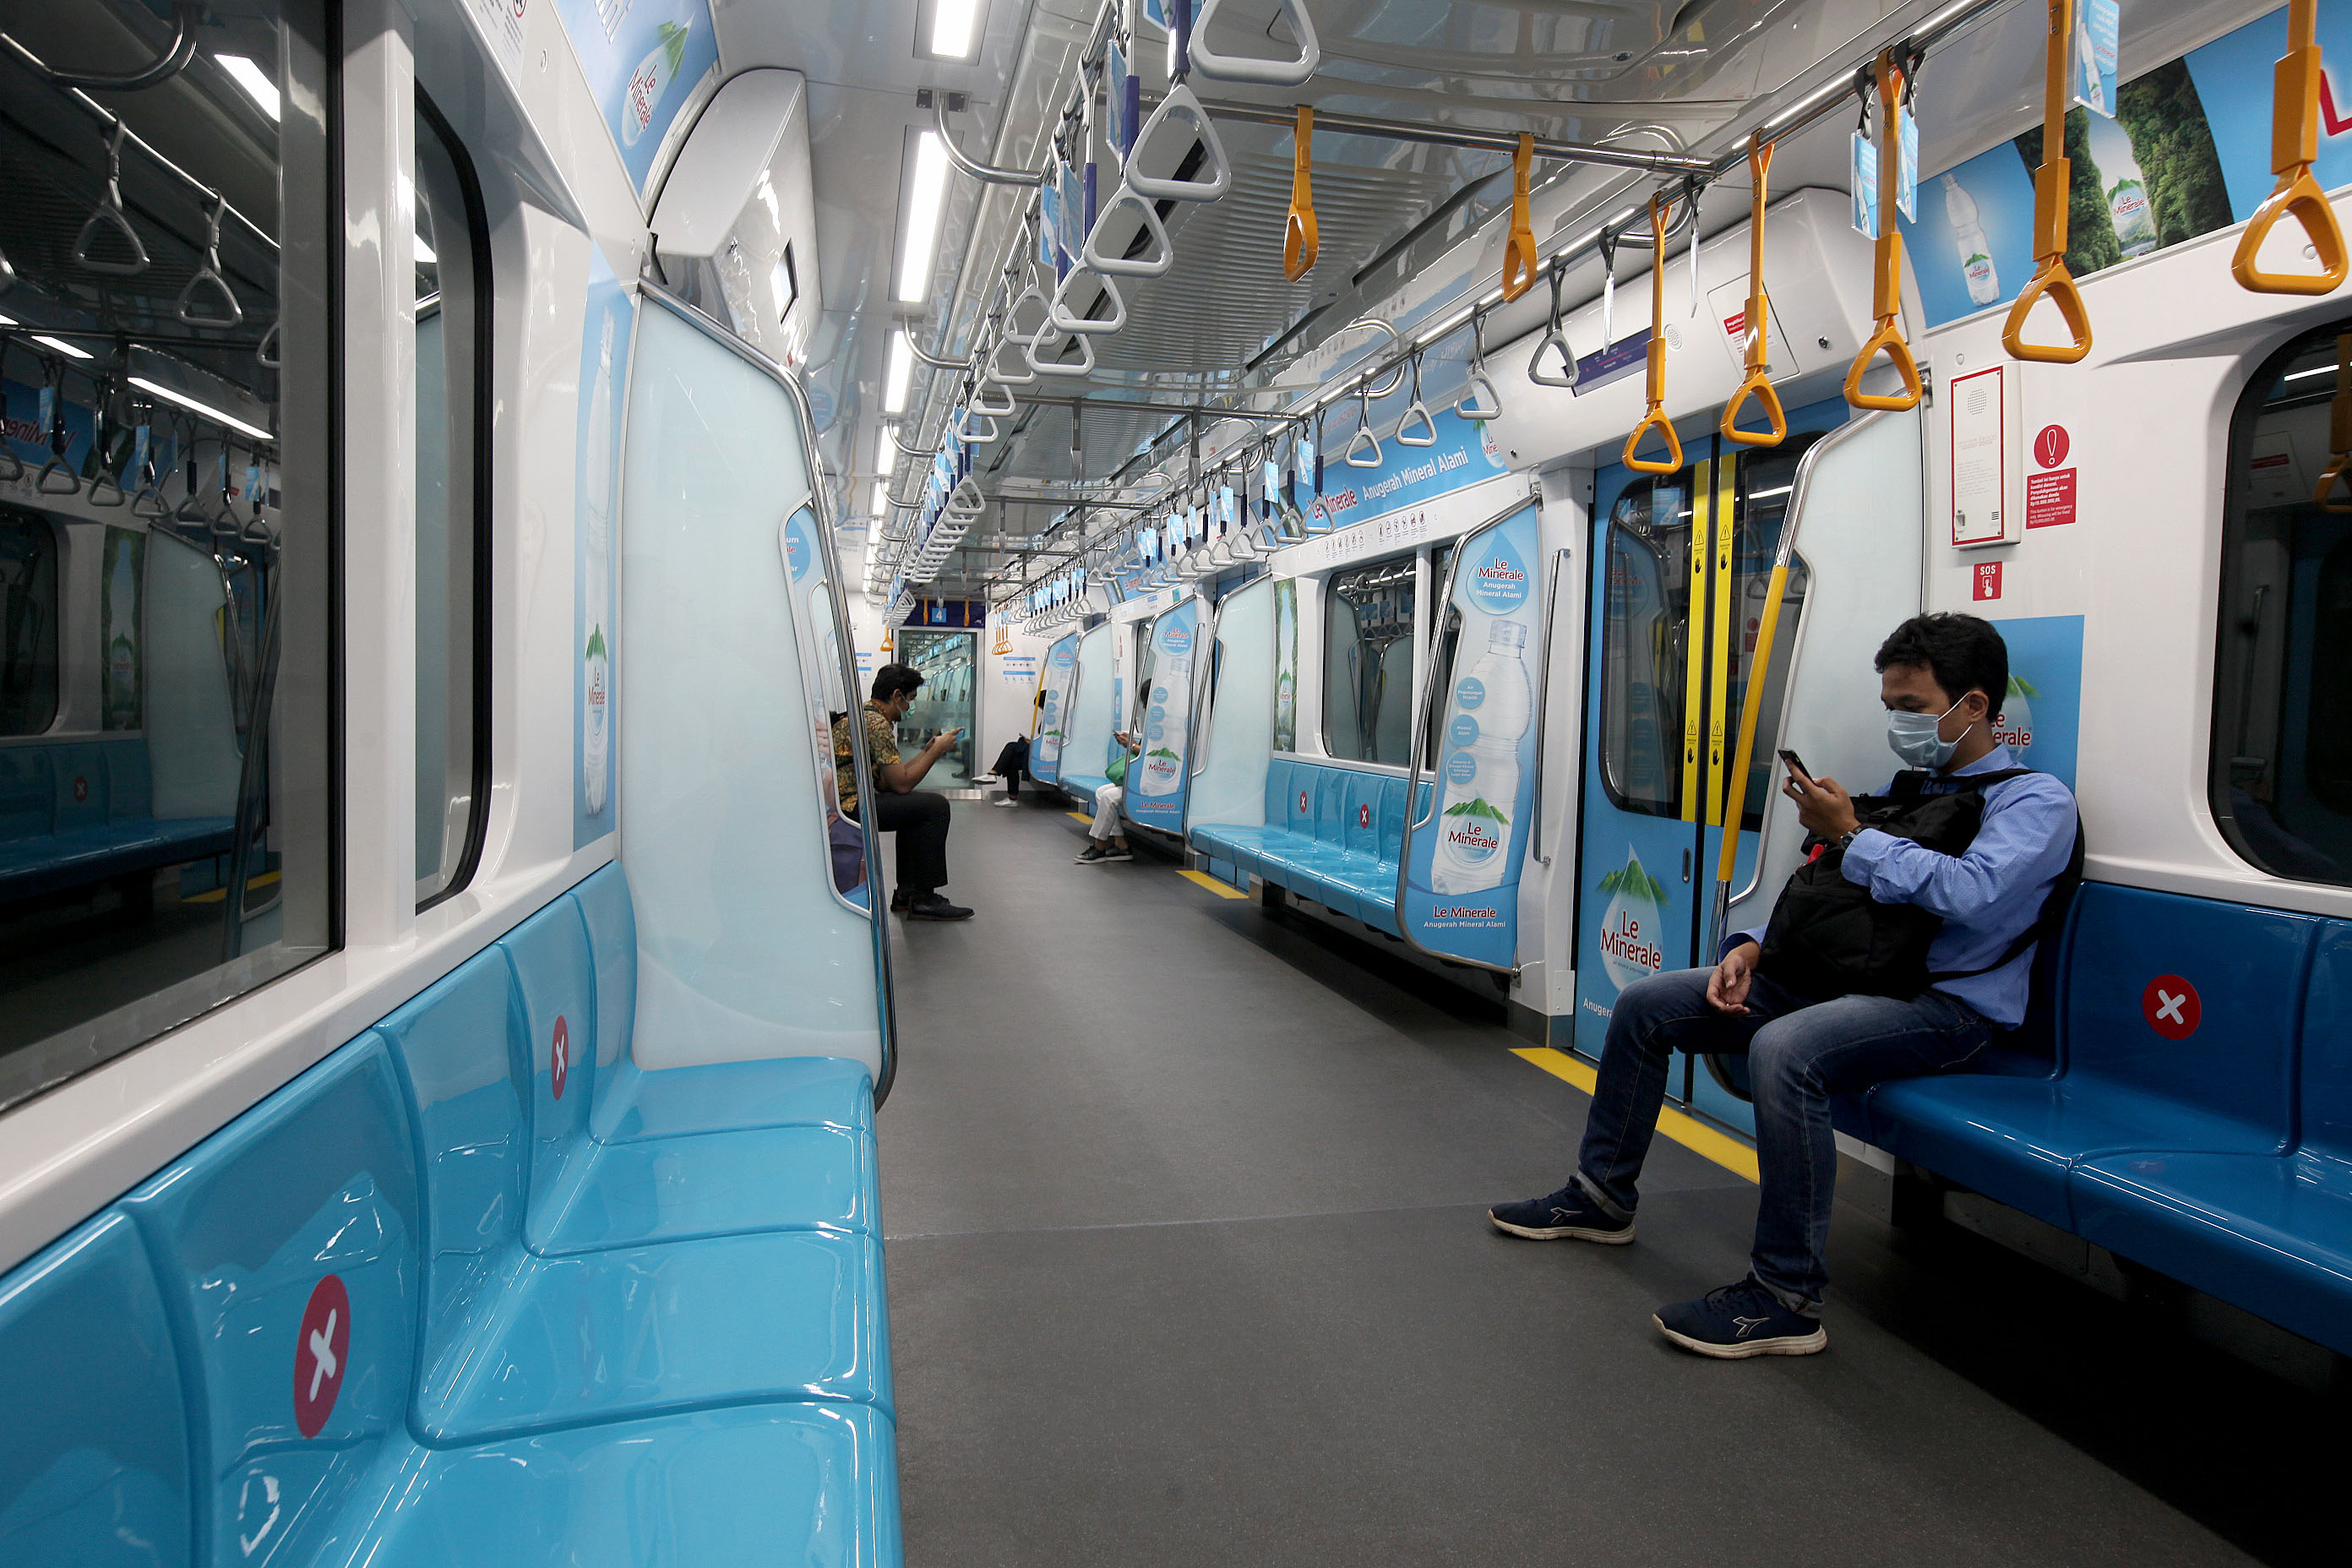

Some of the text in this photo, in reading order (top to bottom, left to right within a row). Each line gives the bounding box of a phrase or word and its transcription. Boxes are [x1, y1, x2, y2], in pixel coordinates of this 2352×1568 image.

[644, 63, 657, 95] Le
[628, 67, 652, 129] Minerale
[2319, 68, 2352, 137] L
[2114, 198, 2145, 216] Minerale
[2121, 195, 2132, 205] Le
[1482, 444, 1499, 456] Mine
[1362, 472, 1402, 502] Anugerah
[1400, 457, 1437, 487] Mineral
[1438, 445, 1469, 474] Alami
[1494, 558, 1508, 569] Le
[1979, 564, 1996, 575] SOS
[1478, 567, 1524, 580] Minerale
[1483, 581, 1516, 590] Anugerah
[1476, 589, 1522, 599] Mineral Alami
[935, 608, 943, 621] 4
[1993, 727, 2031, 747] erale
[1148, 763, 1176, 773] Minerale
[1467, 821, 1481, 836] Le
[1448, 830, 1498, 849] Minerale
[1434, 906, 1496, 918] Le Minerale
[1424, 920, 1457, 928] Anugerah
[1459, 920, 1484, 928] Mineral
[1622, 910, 1639, 939] Le
[1600, 928, 1661, 970] Minerale
[1582, 997, 1612, 1020] Anuger
